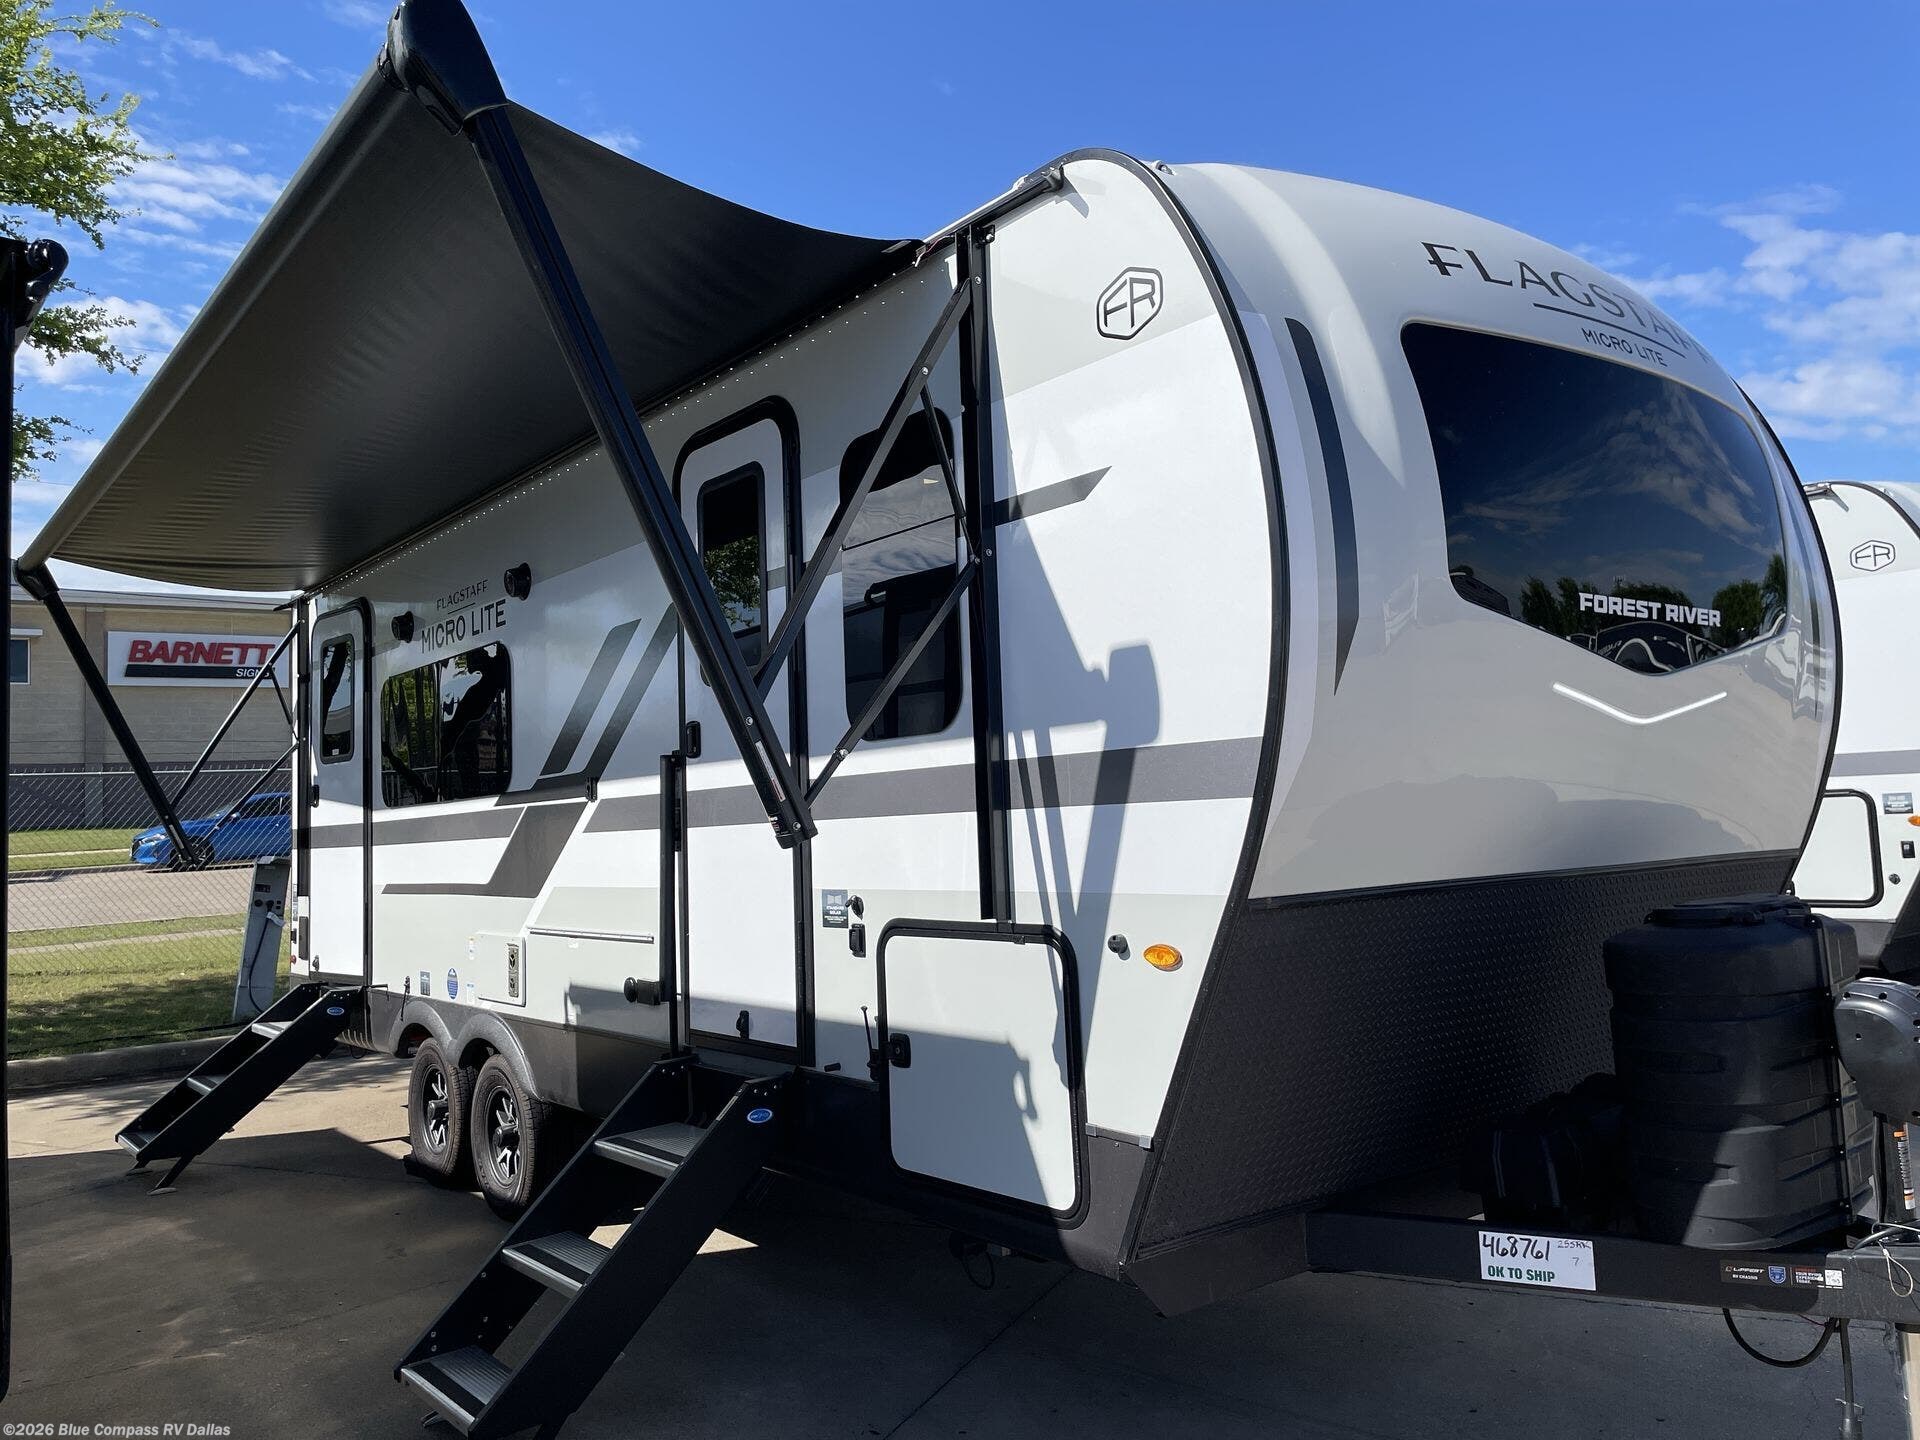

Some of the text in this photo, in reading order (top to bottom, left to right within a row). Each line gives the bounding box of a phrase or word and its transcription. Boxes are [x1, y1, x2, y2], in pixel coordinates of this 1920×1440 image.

[1581, 327, 1668, 367] MICRO LITE
[436, 579, 488, 612] FLAGSTAFF
[1578, 592, 1721, 628] FOREST RIVER
[421, 598, 507, 654] MICRO LITE
[127, 639, 276, 665] BARNETT
[1482, 1233, 1550, 1262] 468761
[1487, 1265, 1556, 1283] OK TO SHIP
